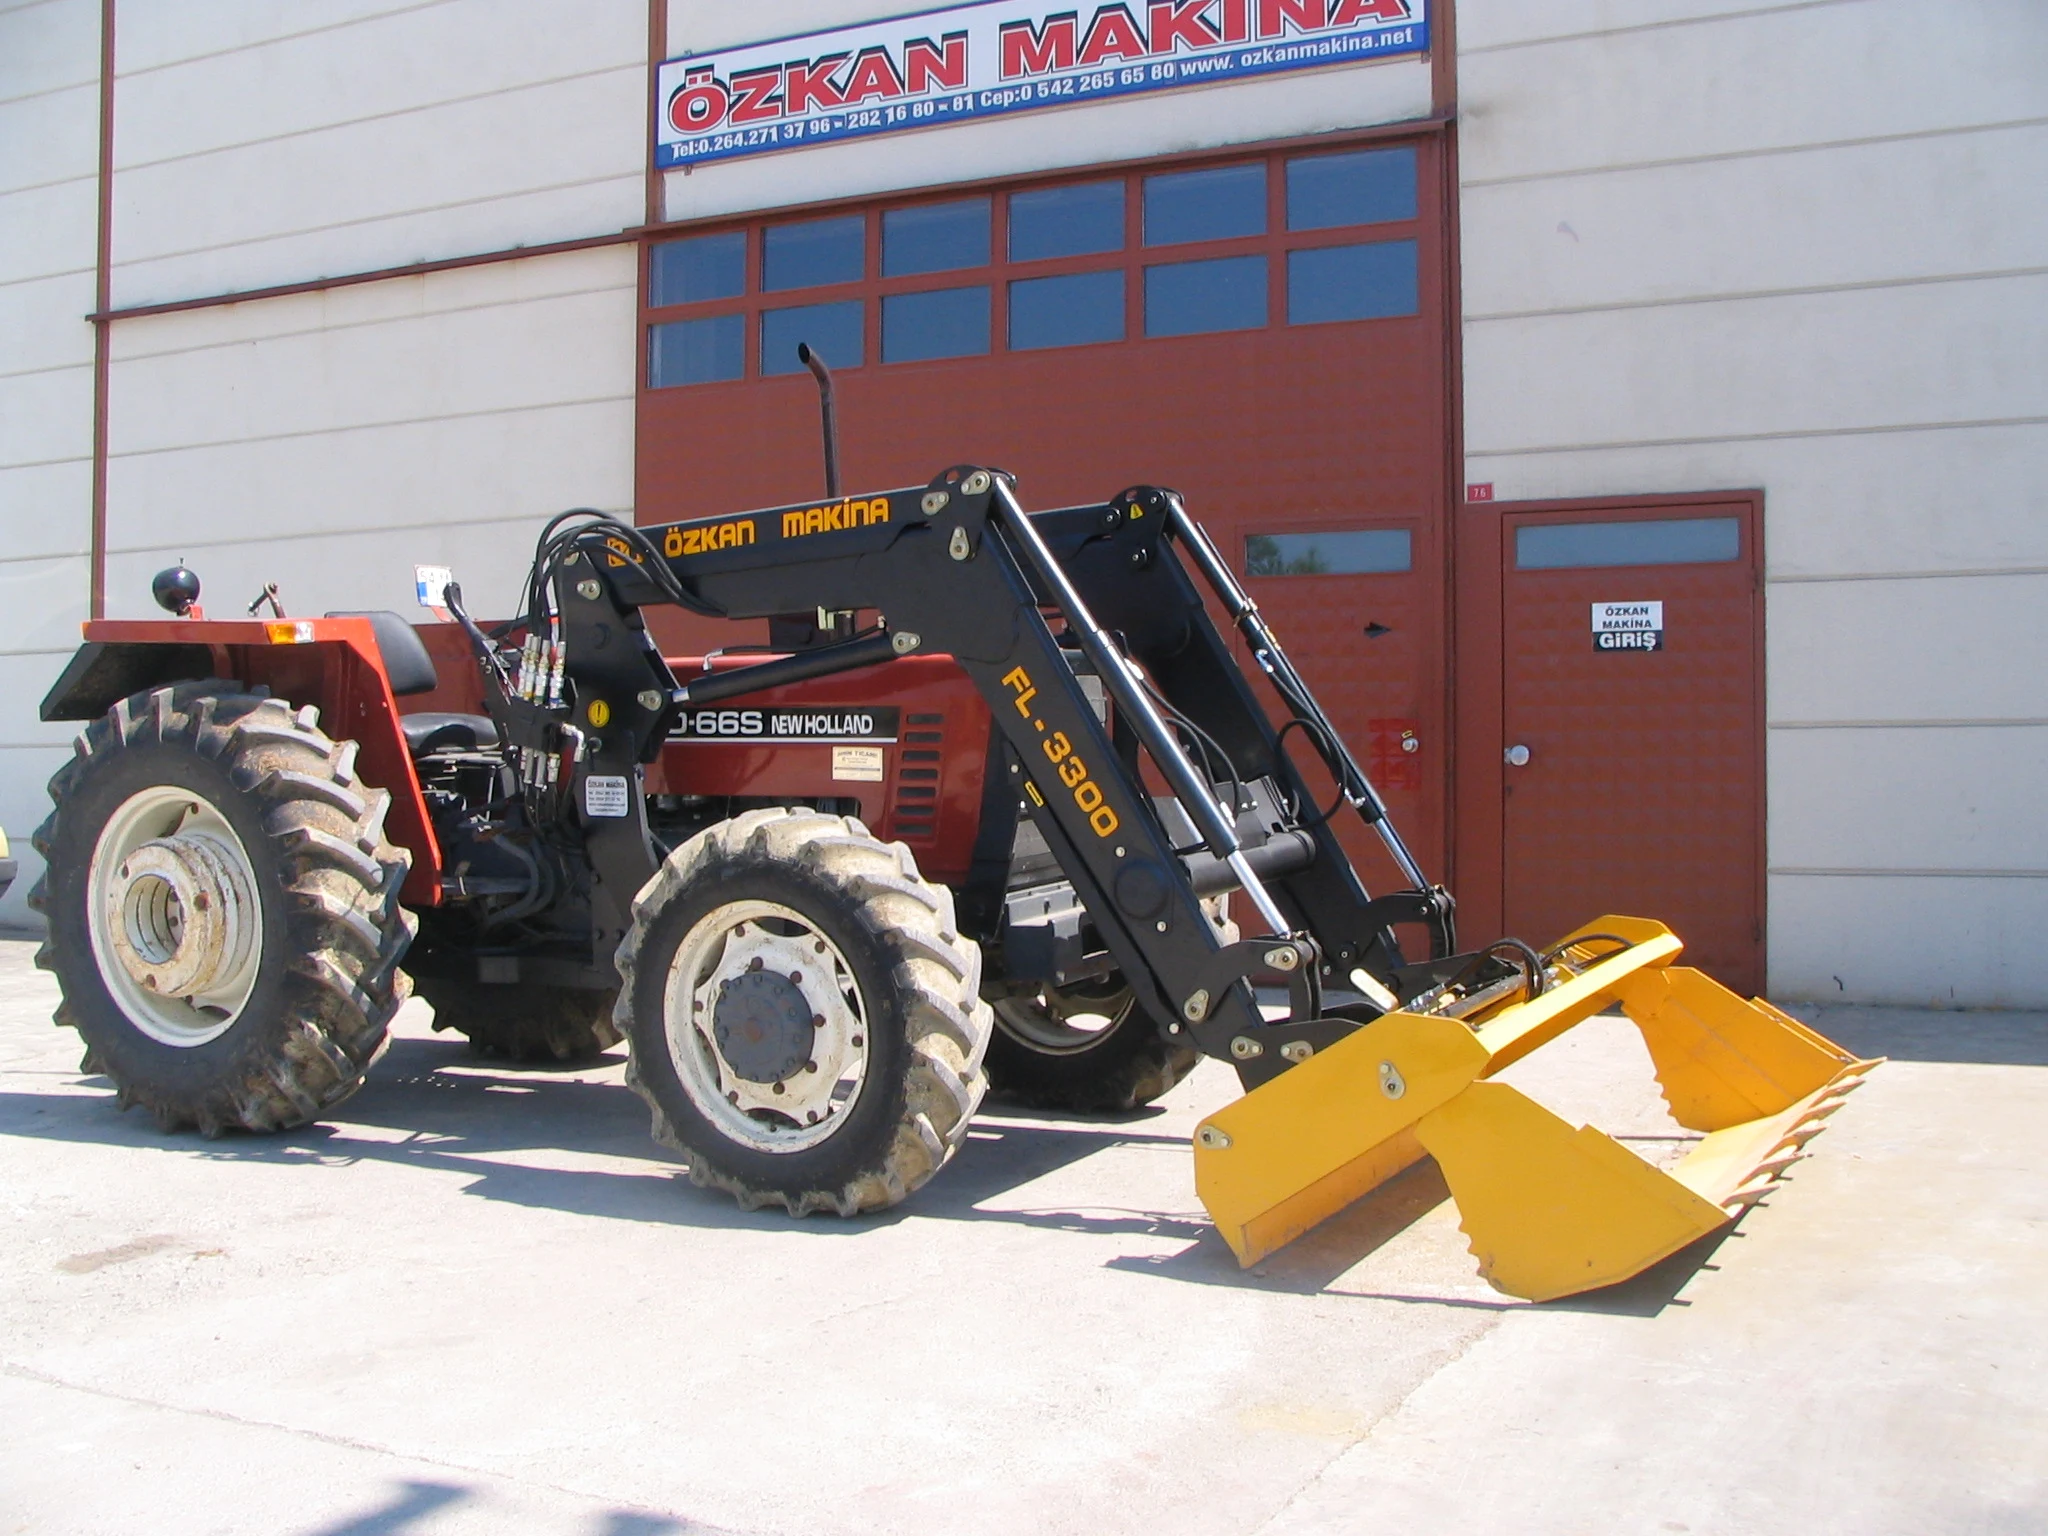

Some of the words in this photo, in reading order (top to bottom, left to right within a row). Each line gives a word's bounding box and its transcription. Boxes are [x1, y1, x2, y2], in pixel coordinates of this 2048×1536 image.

[668, 31, 968, 134] ÖZKAN
[784, 122, 804, 139] 37
[810, 118, 830, 135] 96
[847, 109, 881, 129] 282
[885, 105, 906, 125] 16
[1037, 78, 1074, 98] 542
[1079, 71, 1114, 92] 265
[1121, 67, 1144, 84] 65
[1180, 55, 1234, 77] www.
[1241, 27, 1412, 67] ozkanmakina.net
[1474, 487, 1486, 498] 76
[664, 519, 755, 558] ÖZKAN
[1605, 606, 1649, 616] ÖZKAN
[771, 714, 803, 734] NEW
[805, 714, 873, 734] HOLLAND
[1001, 665, 1119, 837] FL-3300
